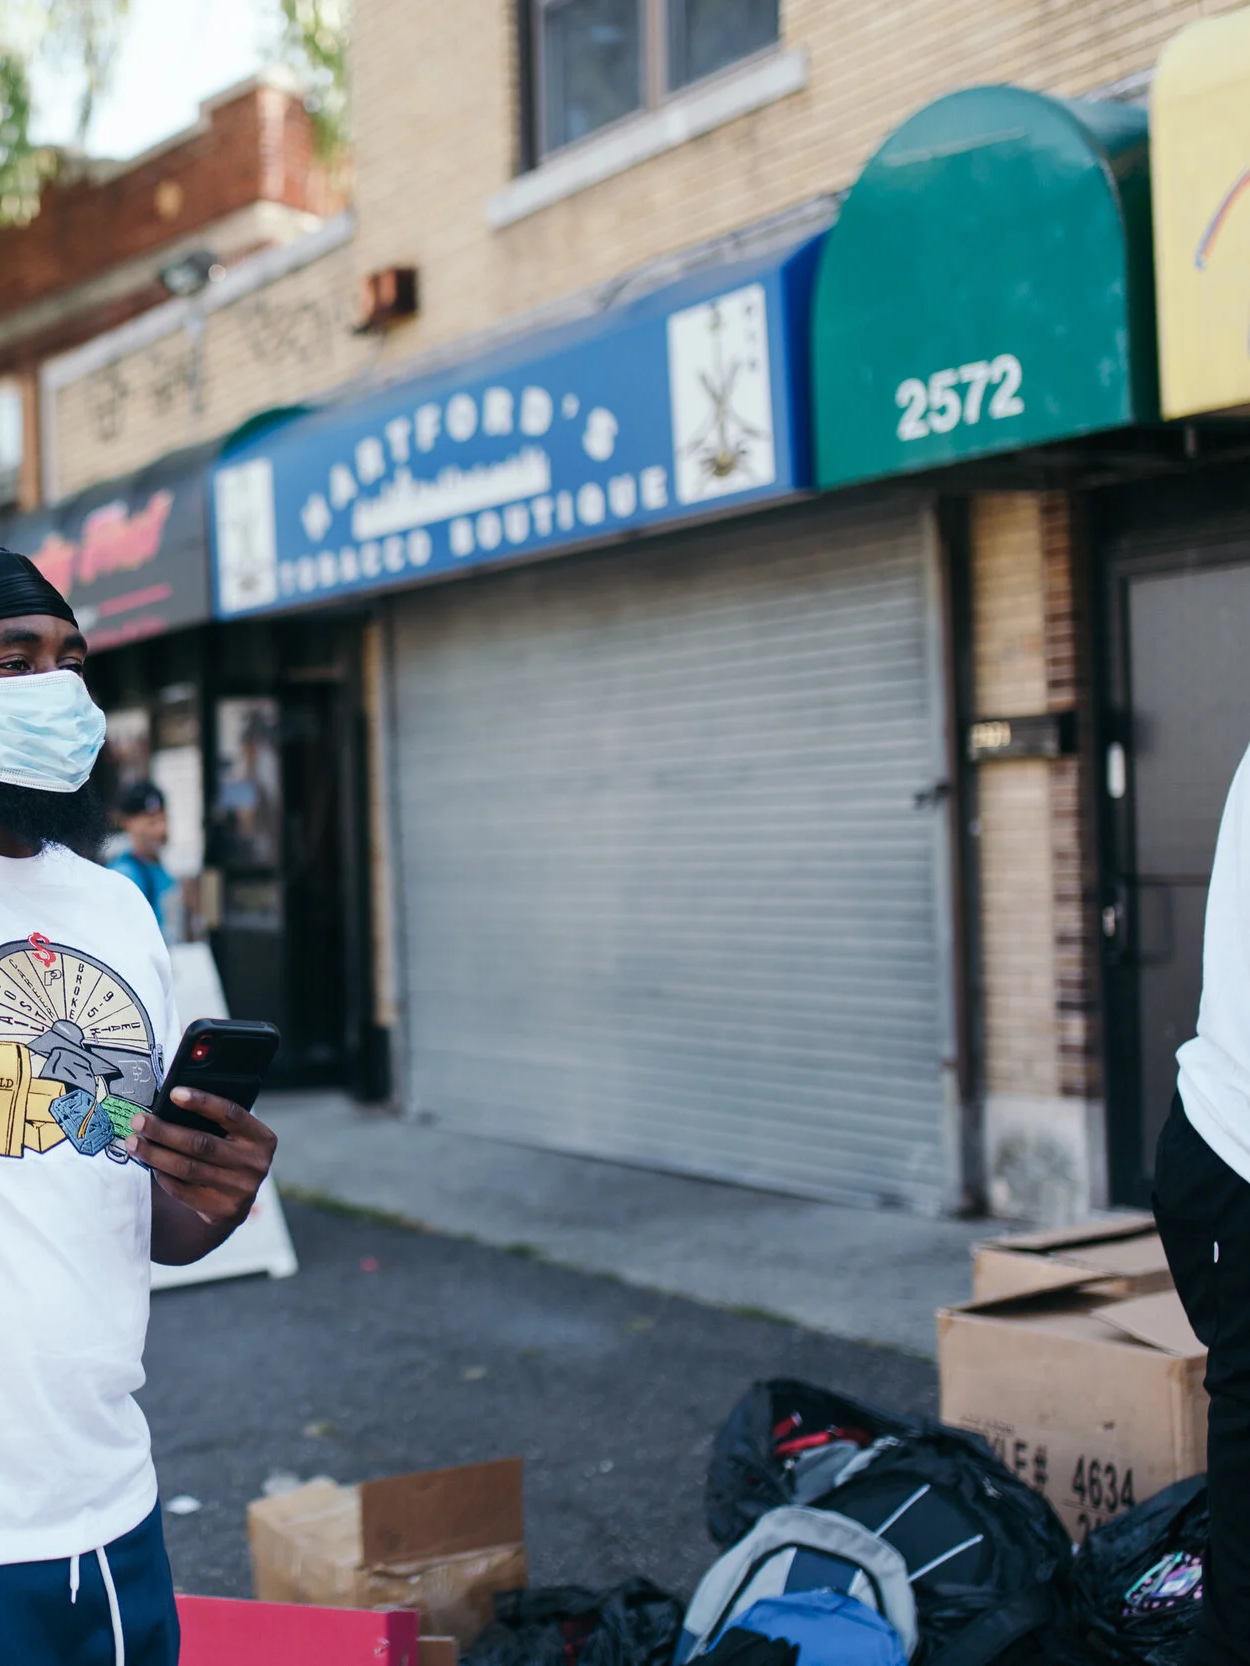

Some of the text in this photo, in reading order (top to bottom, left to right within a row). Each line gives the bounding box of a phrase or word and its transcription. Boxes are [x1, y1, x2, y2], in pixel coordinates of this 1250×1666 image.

[895, 353, 1025, 442] 2572
[278, 527, 432, 594] TOBACCO
[450, 465, 668, 558] BOUTIQUE
[9, 959, 56, 1019] CAREER
[69, 963, 85, 1020] BROKE
[87, 990, 114, 1018] 9-5
[90, 1021, 141, 1037] DEATH
[1072, 1454, 1134, 1514] 4634
